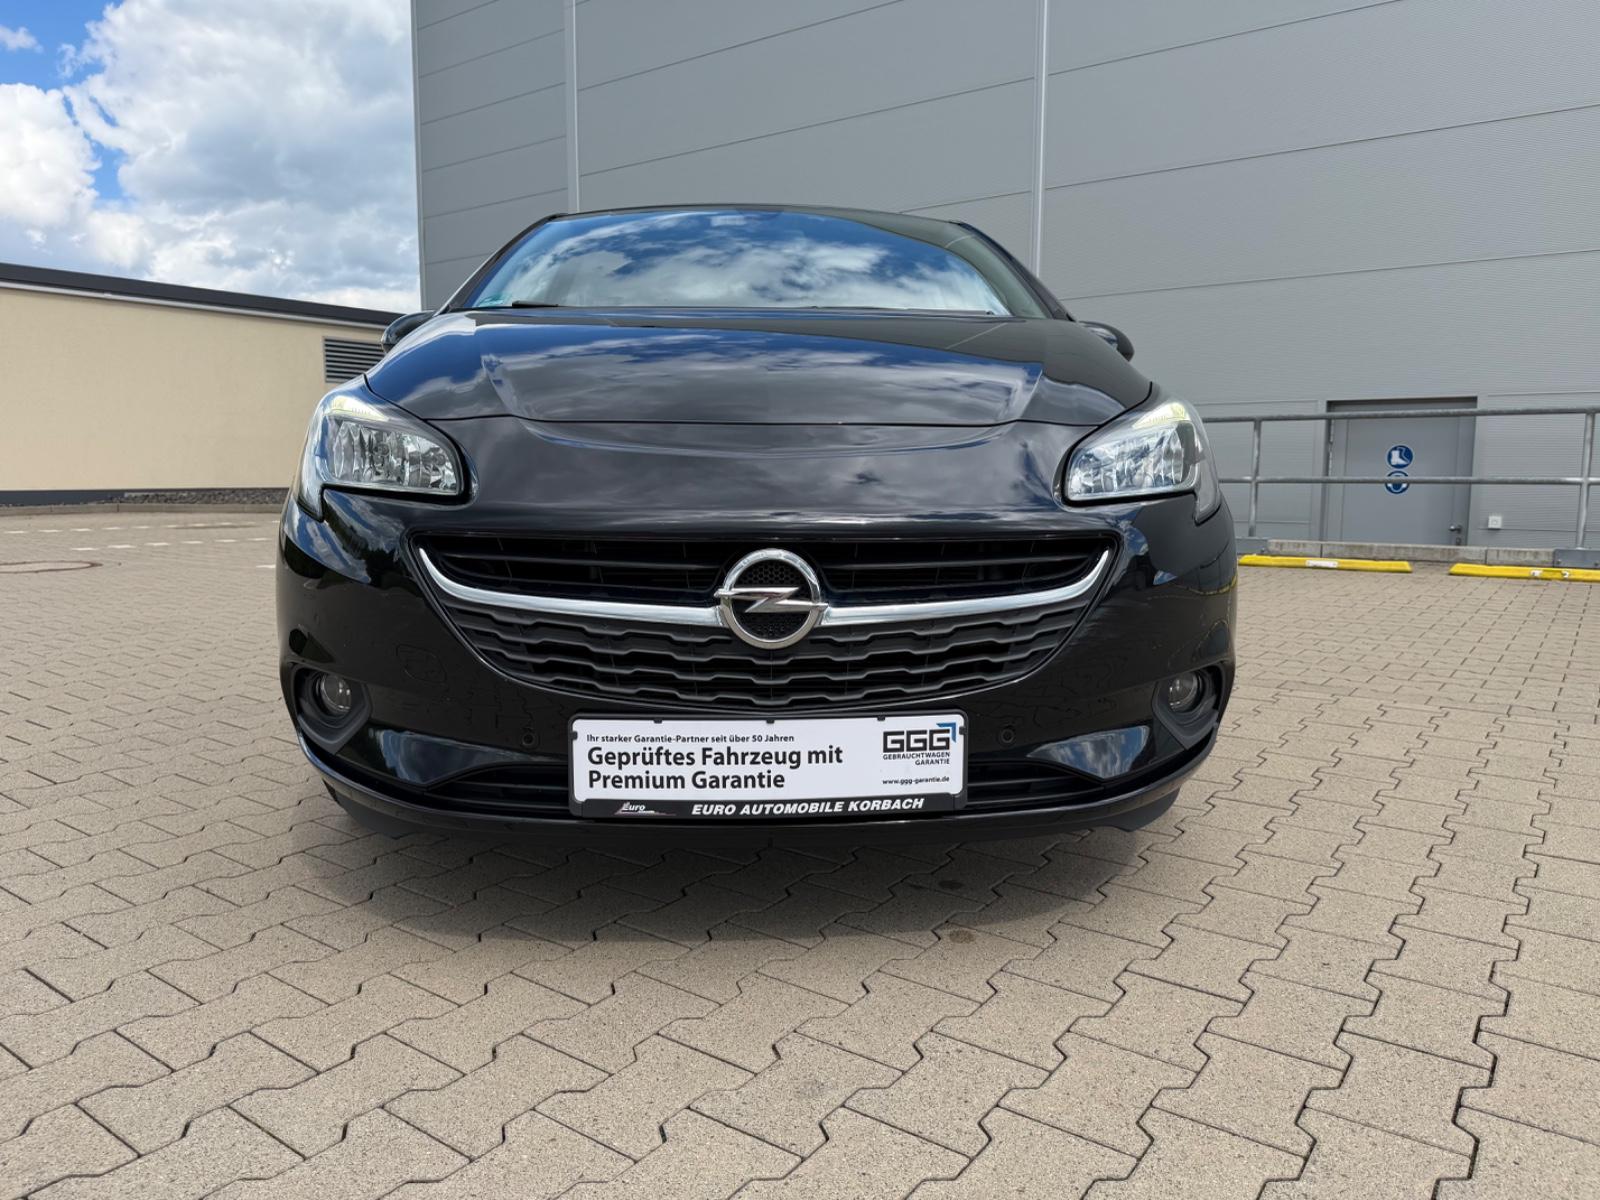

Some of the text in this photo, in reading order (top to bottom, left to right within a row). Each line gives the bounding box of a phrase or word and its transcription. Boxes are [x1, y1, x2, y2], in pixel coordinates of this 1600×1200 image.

[586, 734, 599, 743] Ihr
[601, 734, 632, 743] starker
[634, 734, 709, 744] Garantie-Partner
[711, 735, 727, 743] seit
[765, 734, 794, 742] Jahren
[883, 729, 950, 753] GGG
[587, 745, 843, 770] Geprüftes Fahrzeug mit
[883, 751, 950, 760] GEBRAUCHTWAGEN
[588, 770, 785, 789] Premium Garantie
[882, 776, 950, 785] www.ggg-garantie.de
[692, 798, 924, 815] EURO AUTOMOBILE KORBACH
